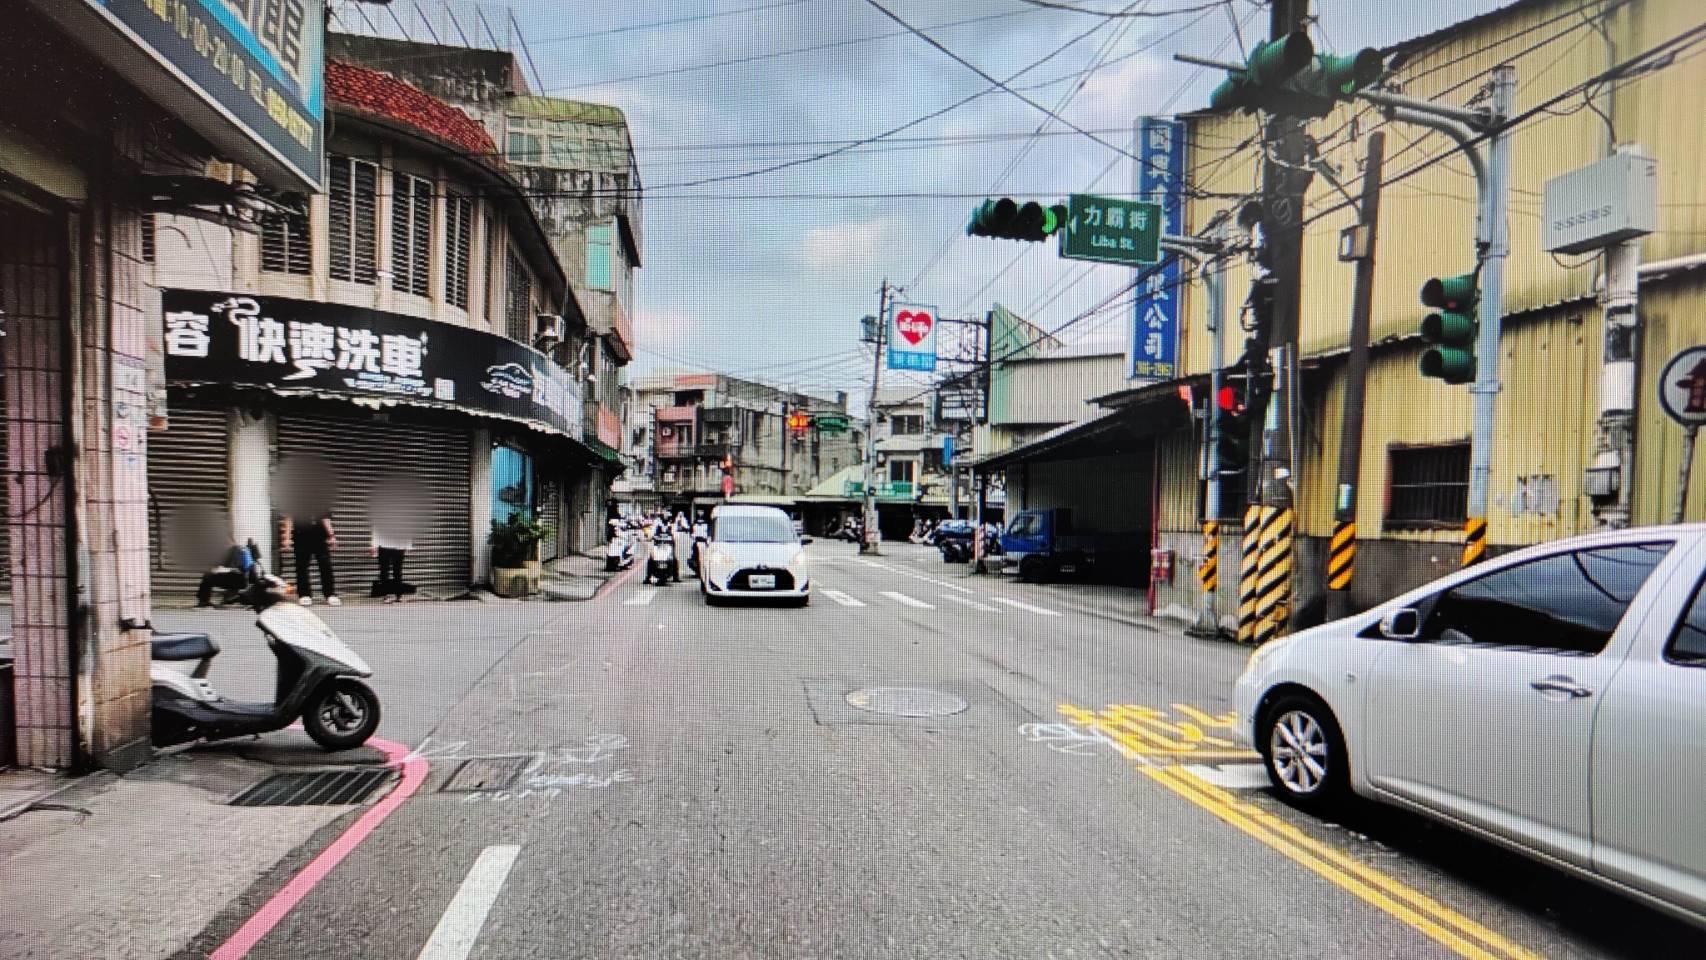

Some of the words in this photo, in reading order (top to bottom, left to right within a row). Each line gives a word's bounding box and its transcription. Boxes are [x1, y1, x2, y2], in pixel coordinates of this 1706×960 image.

[1084, 206, 1148, 231] 力霸街
[230, 298, 424, 382] 快速洗車
